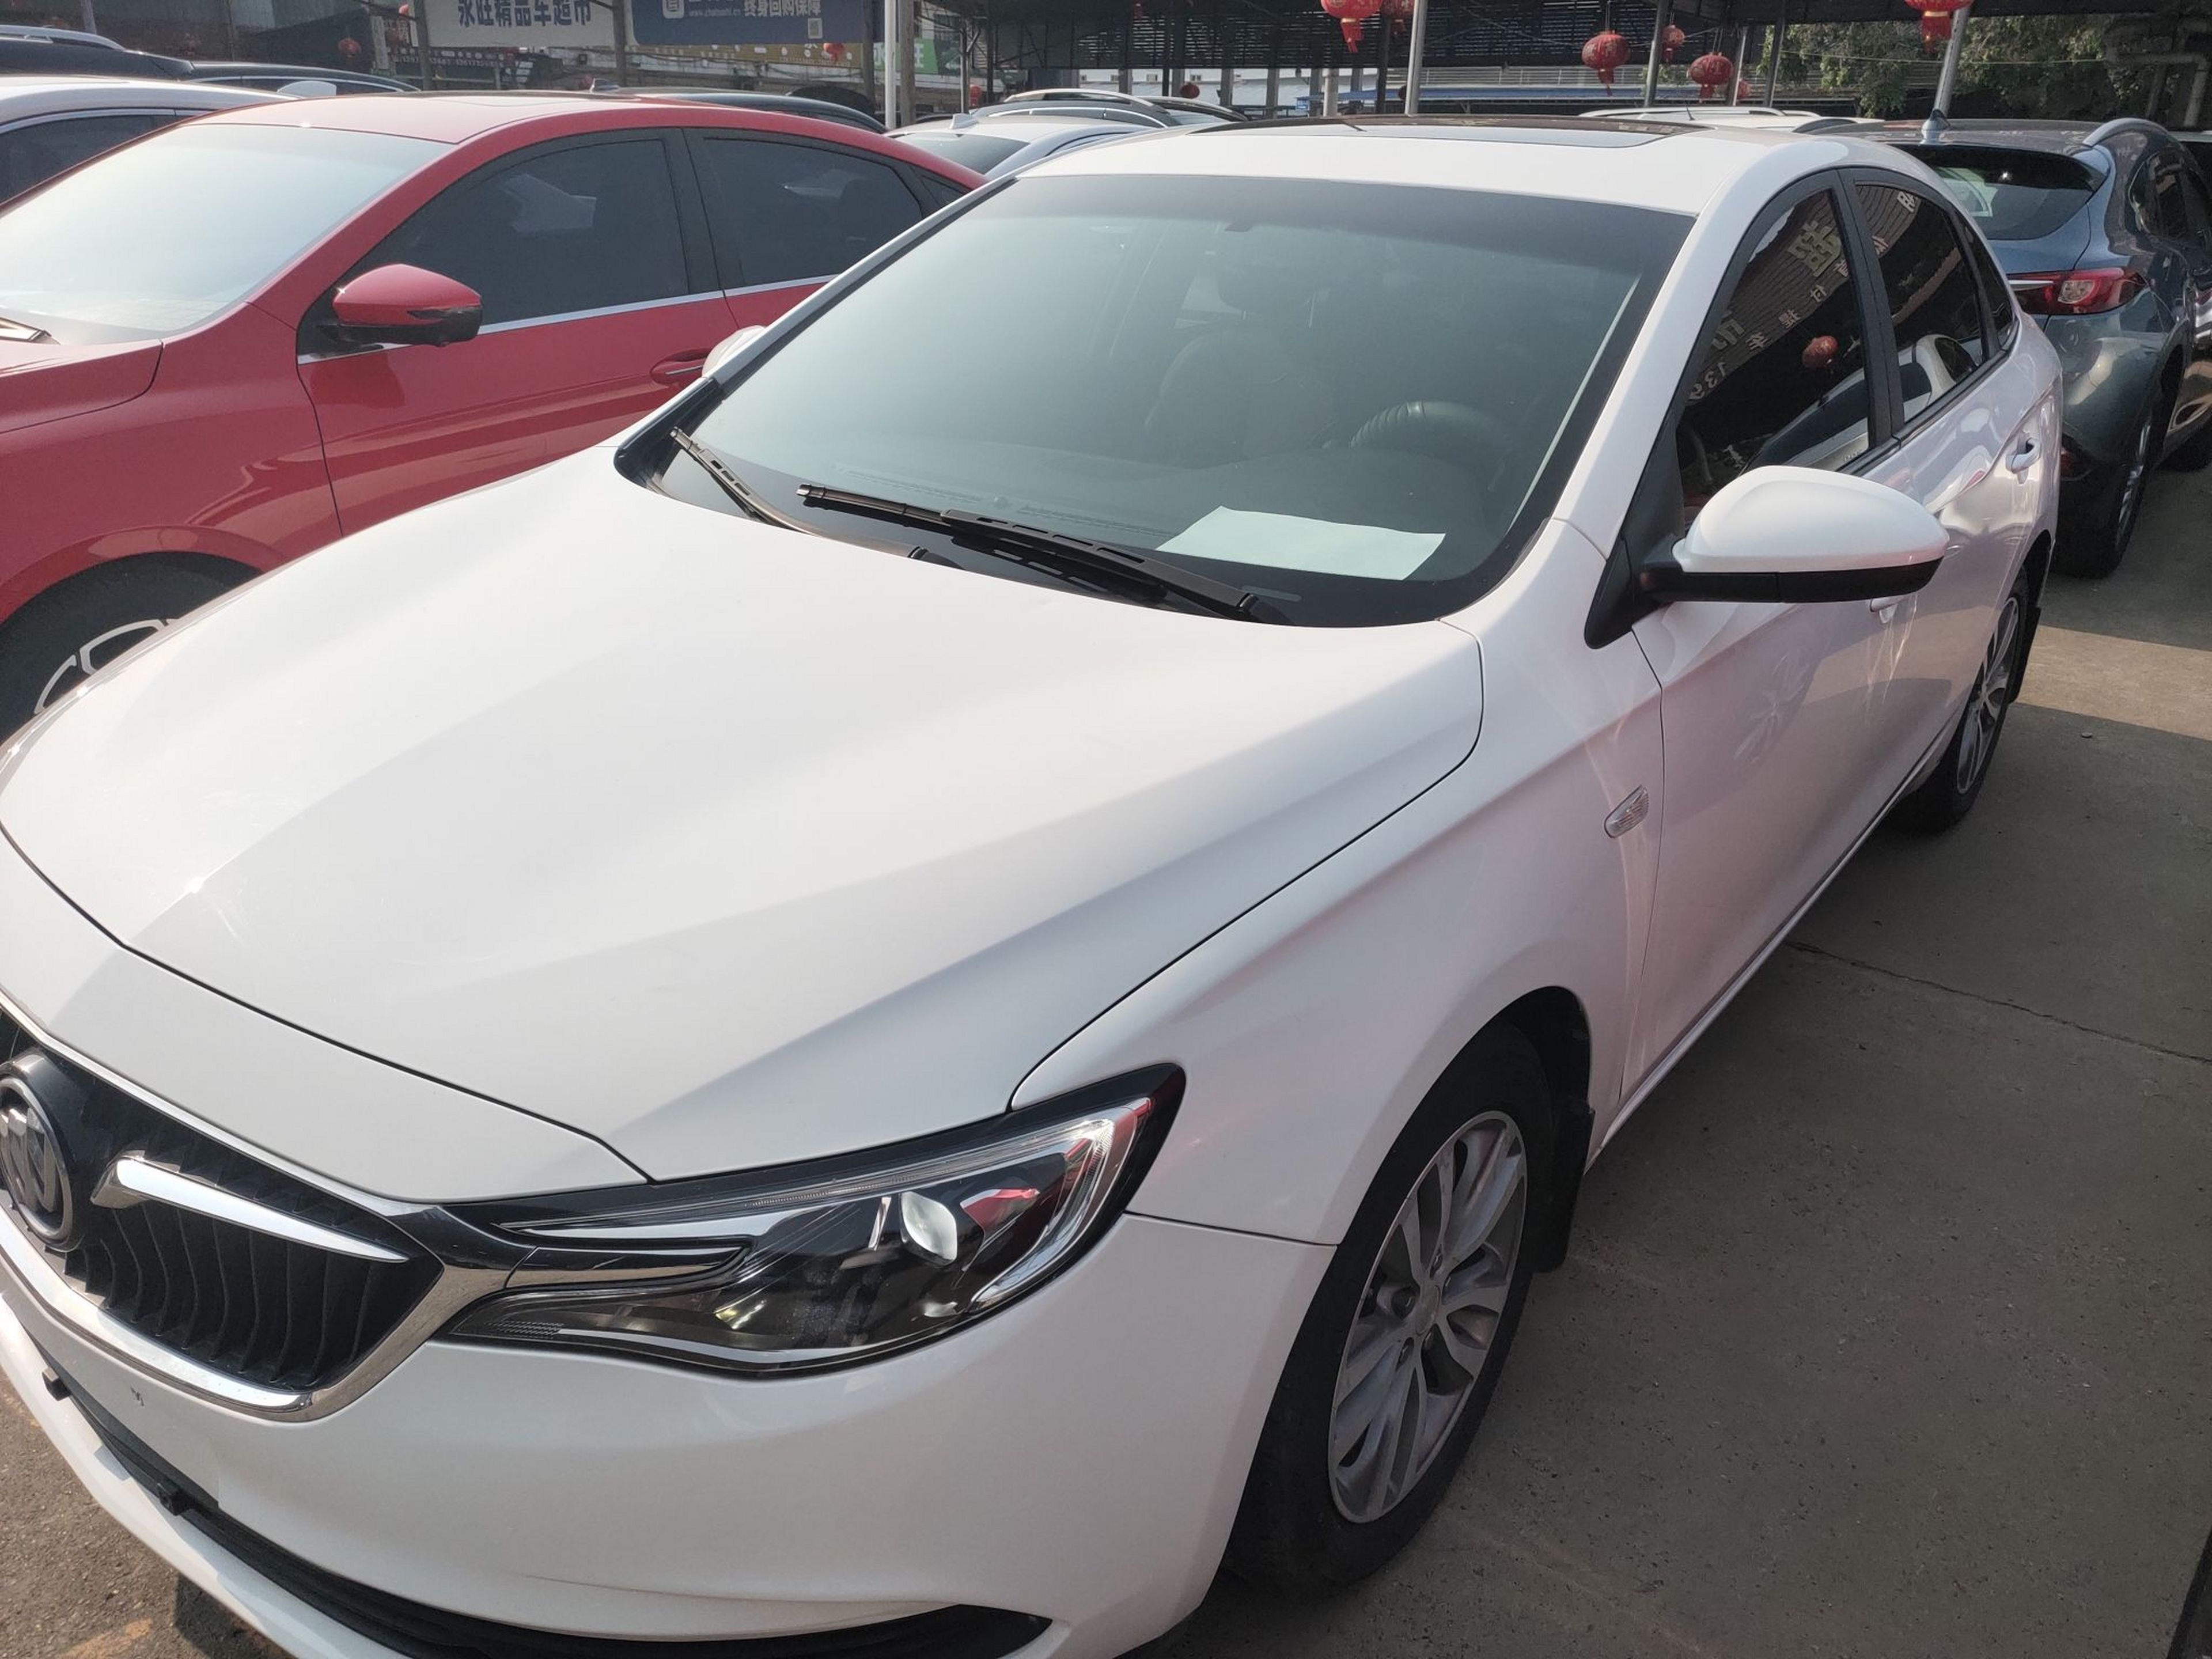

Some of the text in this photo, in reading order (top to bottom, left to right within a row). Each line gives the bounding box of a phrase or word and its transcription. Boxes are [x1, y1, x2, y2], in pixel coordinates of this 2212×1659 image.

[458, 0, 591, 26] 永旺精品车超市
[745, 0, 821, 16] 终身回购保障
